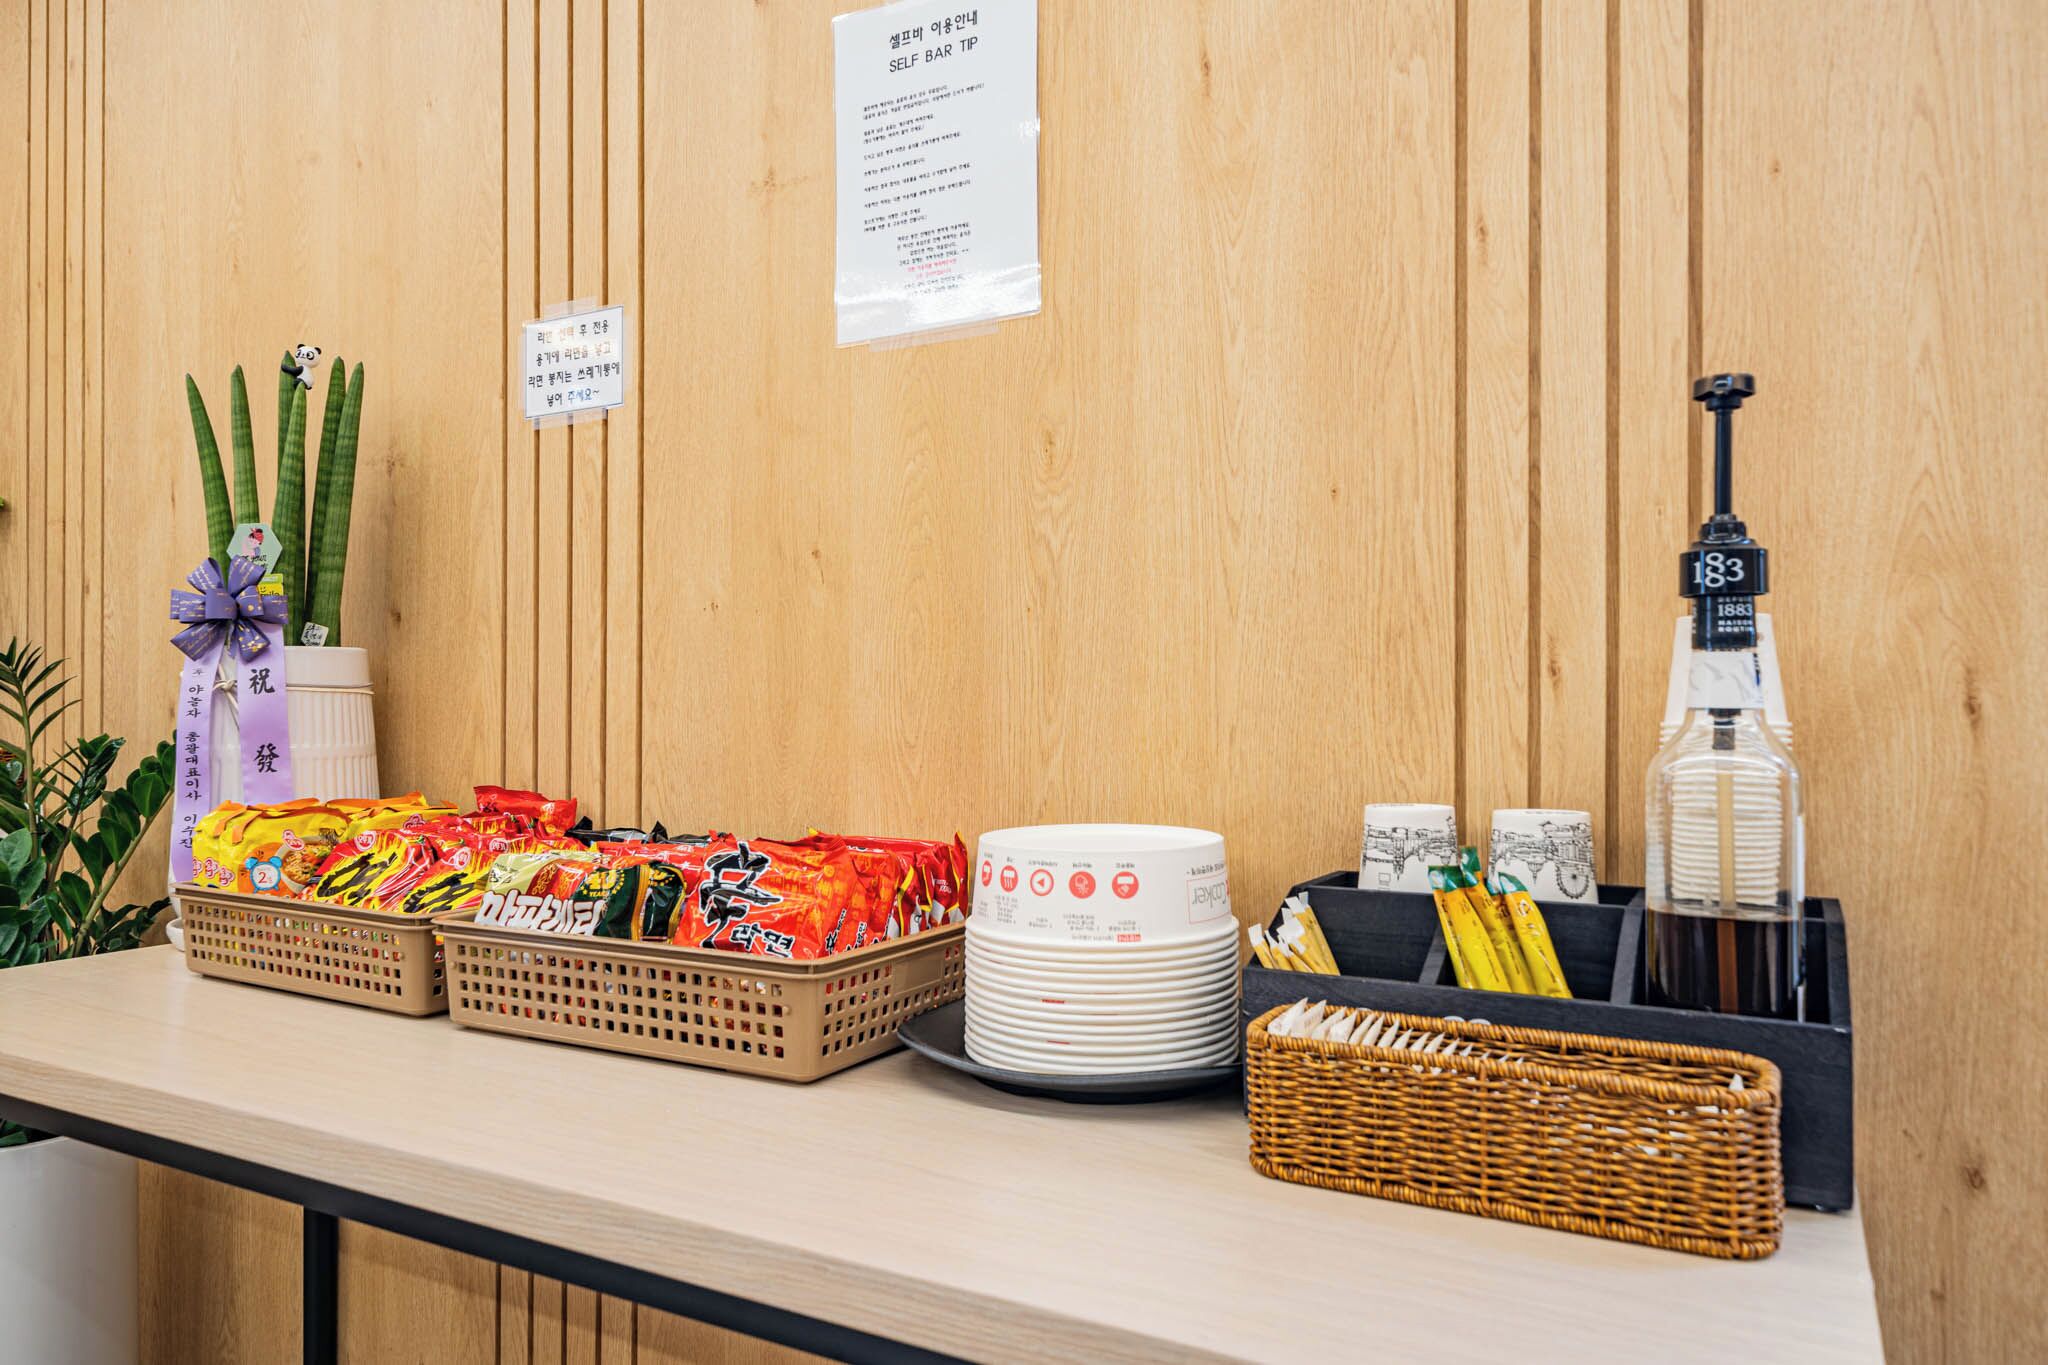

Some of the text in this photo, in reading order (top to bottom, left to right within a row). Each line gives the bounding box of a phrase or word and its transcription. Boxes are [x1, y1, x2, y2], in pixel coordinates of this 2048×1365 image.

[889, 9, 978, 49] 셀프바 이용안내
[889, 36, 978, 73] SELF BAR TIP
[579, 324, 587, 336] 후
[592, 320, 609, 335] 전용
[536, 350, 560, 367] 용기에
[564, 345, 588, 360] 라면을
[528, 361, 620, 388] 라면 봉지는 쓰레기통에
[546, 392, 563, 408] 넣어
[1717, 603, 1753, 617] 1883
[249, 667, 280, 773] 祝 發
[730, 922, 796, 959] 라면
